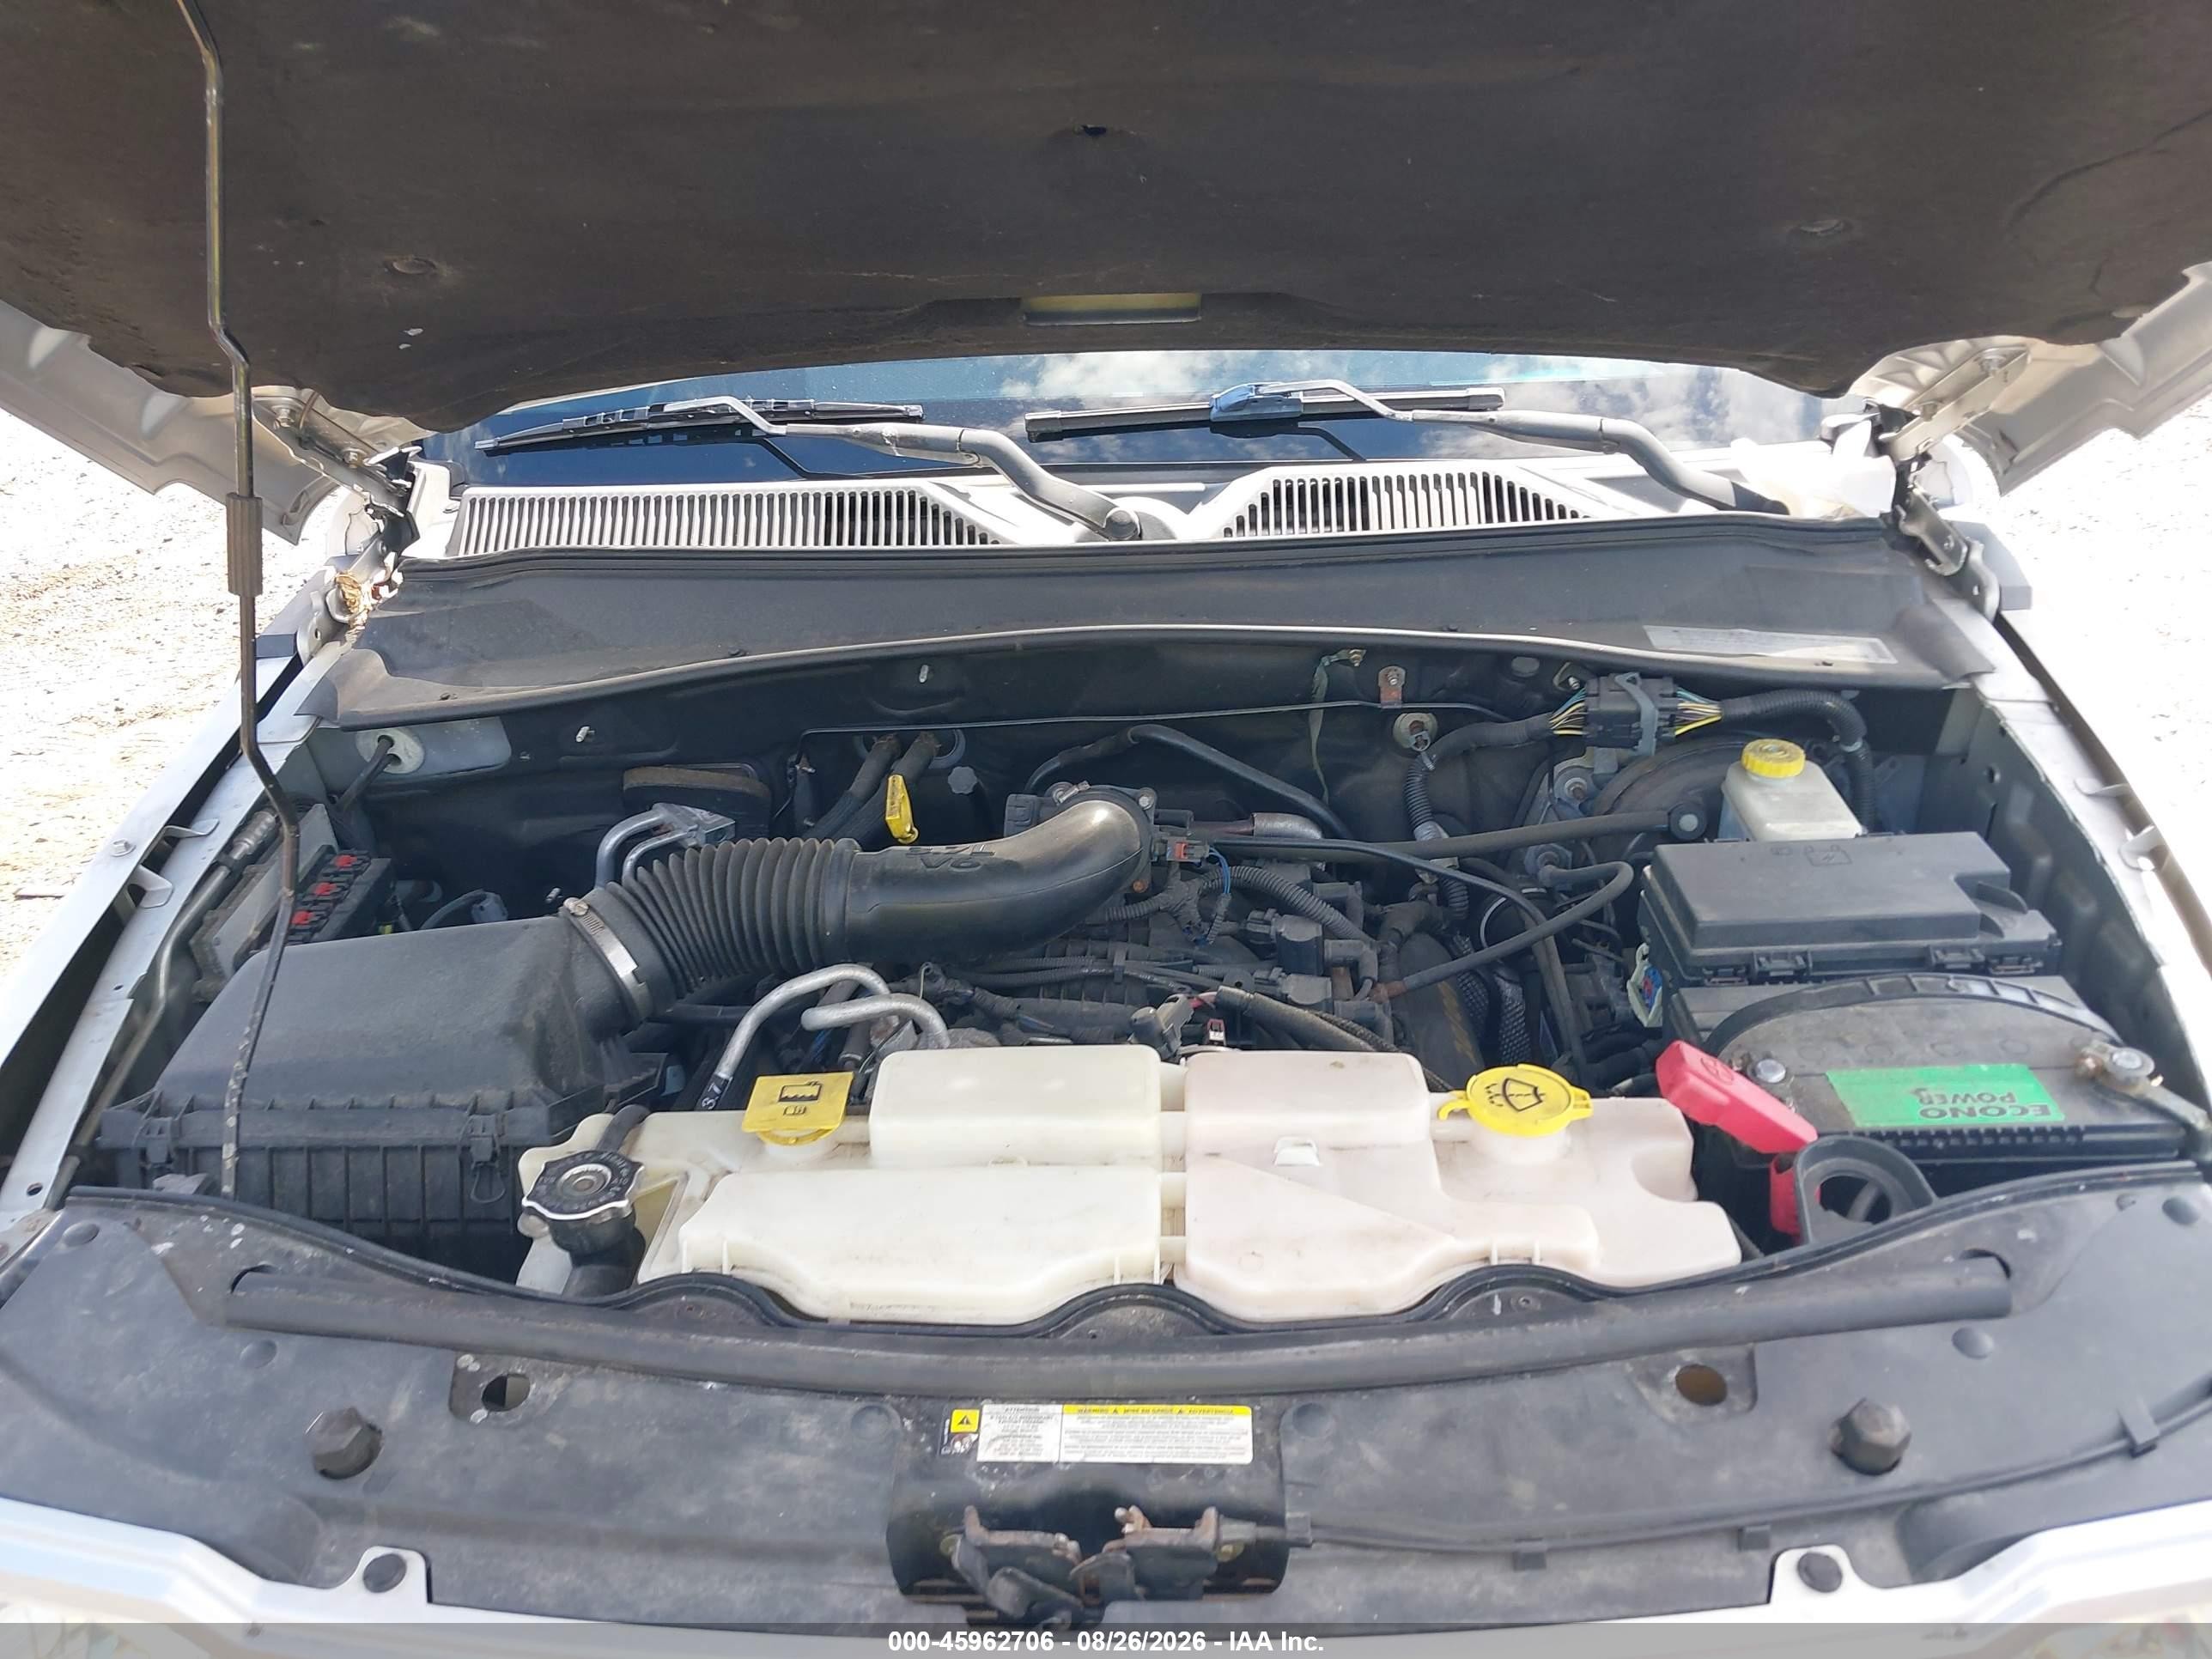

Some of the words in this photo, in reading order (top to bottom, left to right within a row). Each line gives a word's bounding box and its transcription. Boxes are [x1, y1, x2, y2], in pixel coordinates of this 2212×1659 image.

[920, 856, 982, 870] V6
[1911, 1088, 2016, 1105] POWER
[1919, 1103, 2052, 1120] ECONO
